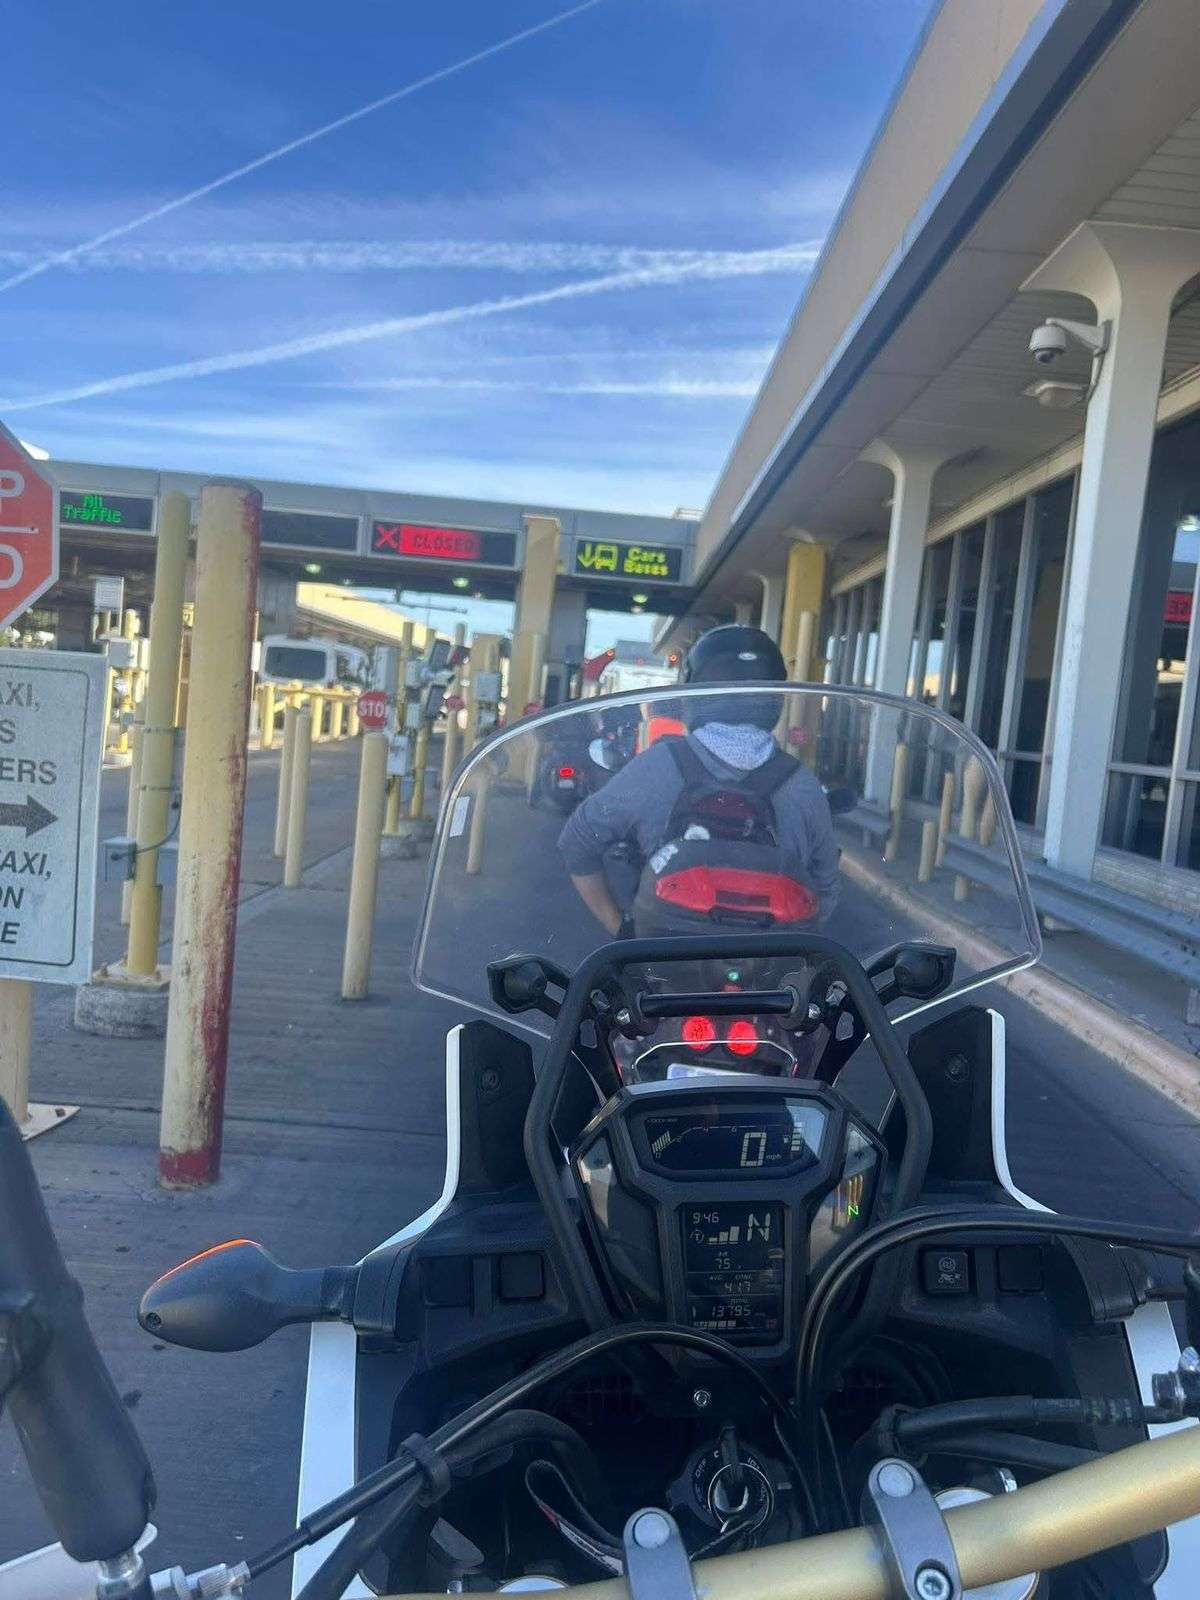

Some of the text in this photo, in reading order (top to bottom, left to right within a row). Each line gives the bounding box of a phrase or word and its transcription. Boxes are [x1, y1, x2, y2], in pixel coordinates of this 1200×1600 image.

[628, 547, 666, 563] Cars
[0, 682, 40, 712] XI,
[0, 756, 57, 785] ERS
[740, 1132, 767, 1167] 0
[847, 1204, 859, 1216] N
[746, 1212, 771, 1242] N
